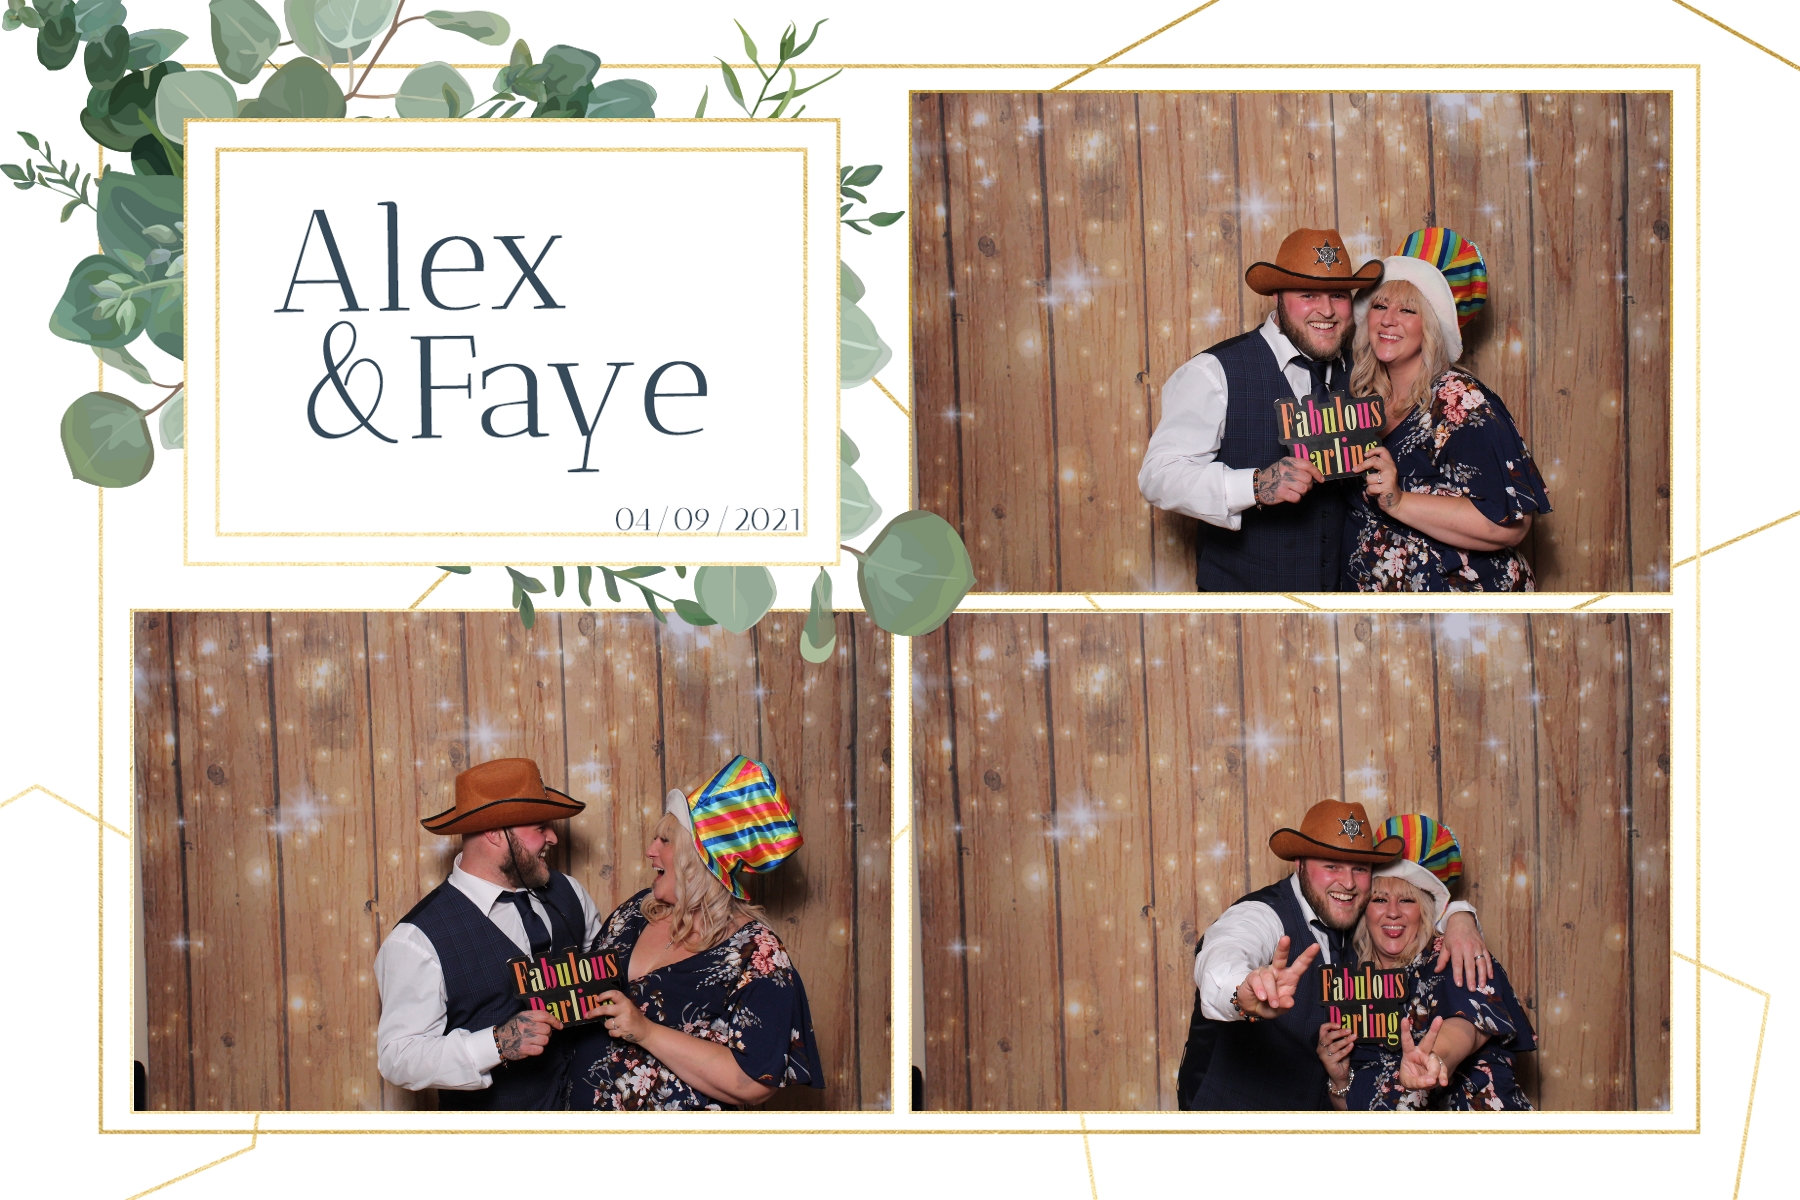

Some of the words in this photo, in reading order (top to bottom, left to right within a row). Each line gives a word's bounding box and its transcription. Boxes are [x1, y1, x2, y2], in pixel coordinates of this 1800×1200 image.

[1280, 396, 1383, 440] Fabulous
[512, 952, 618, 995] Fabulous
[1321, 966, 1405, 1002] Fabulous
